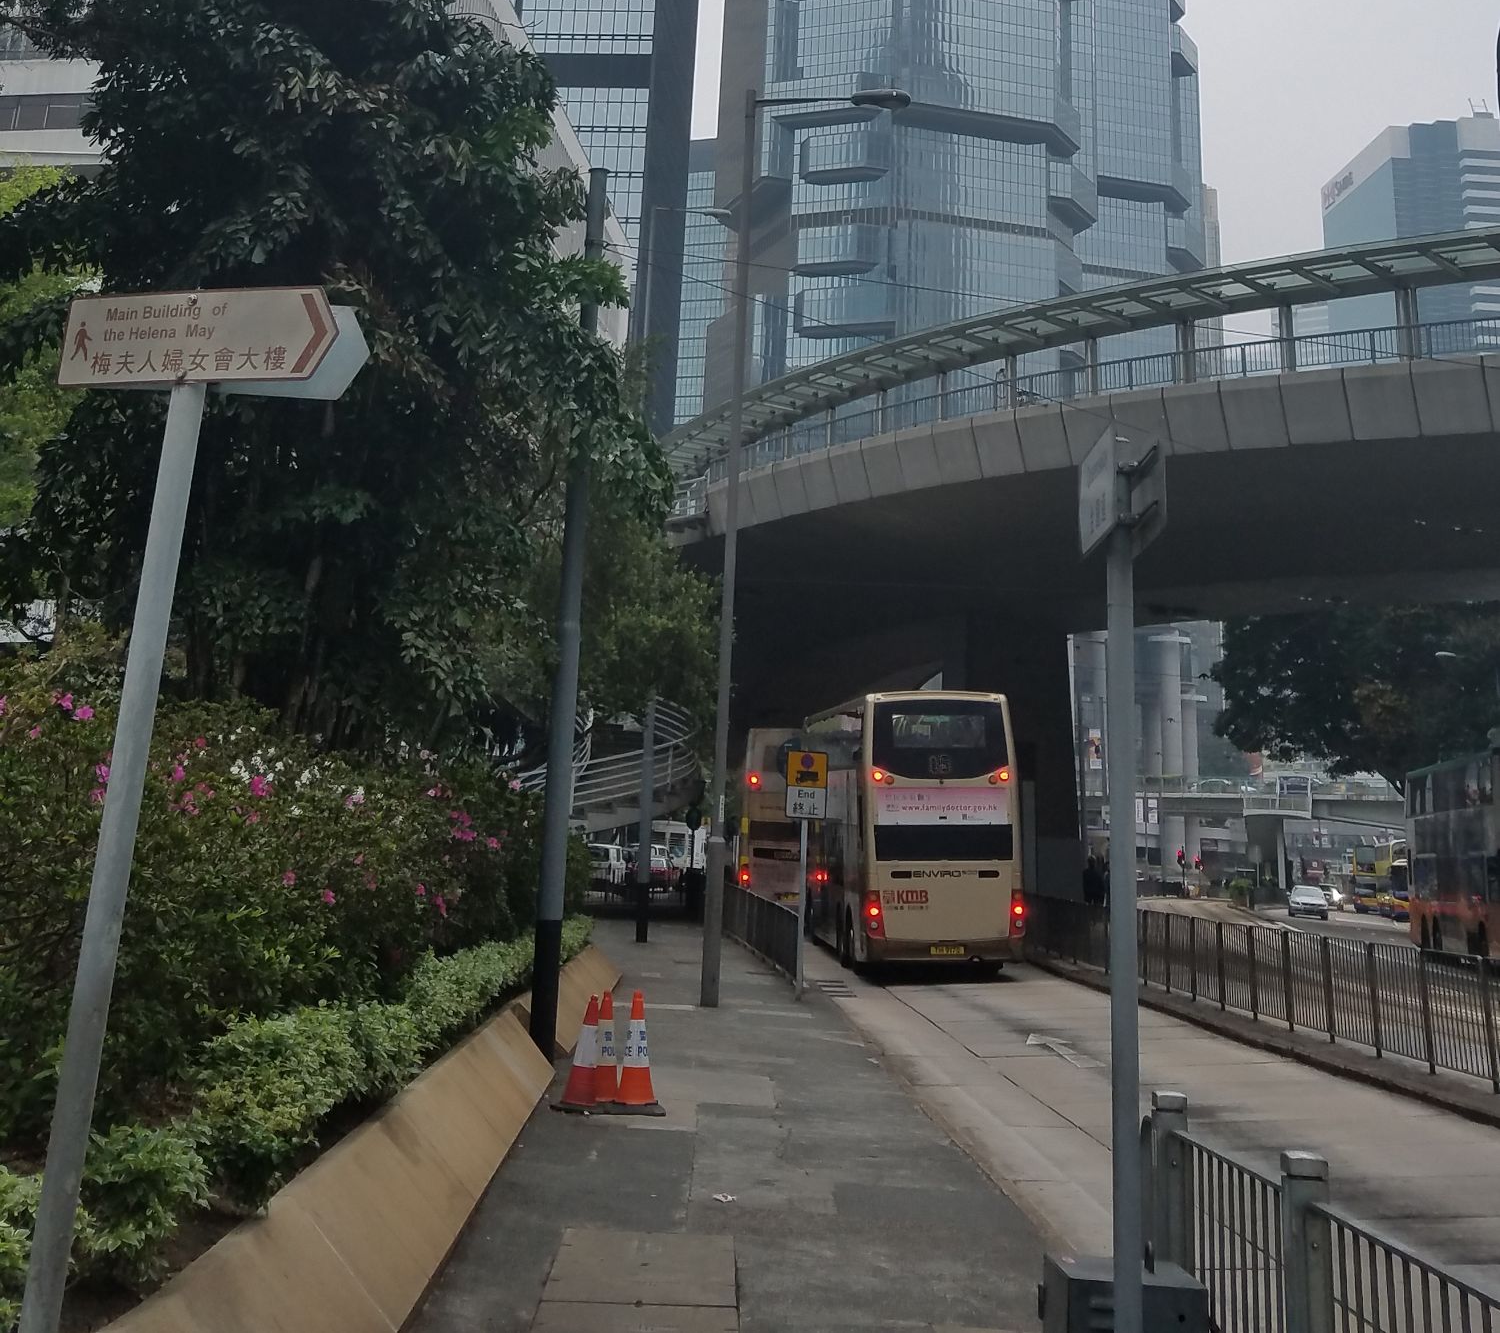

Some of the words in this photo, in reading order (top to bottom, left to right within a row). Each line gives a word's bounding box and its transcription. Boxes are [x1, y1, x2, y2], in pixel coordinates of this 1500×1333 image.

[106, 306, 138, 322] Main
[143, 303, 201, 320] Building
[212, 302, 228, 317] of
[103, 327, 125, 342] the
[129, 325, 176, 341] Helena
[185, 324, 215, 340] May
[91, 346, 288, 376] 梅夫人婦女會大樓
[798, 789, 815, 799] End
[792, 802, 819, 816] 終止
[912, 870, 962, 878] ENVIRO
[897, 890, 929, 904] KMB
